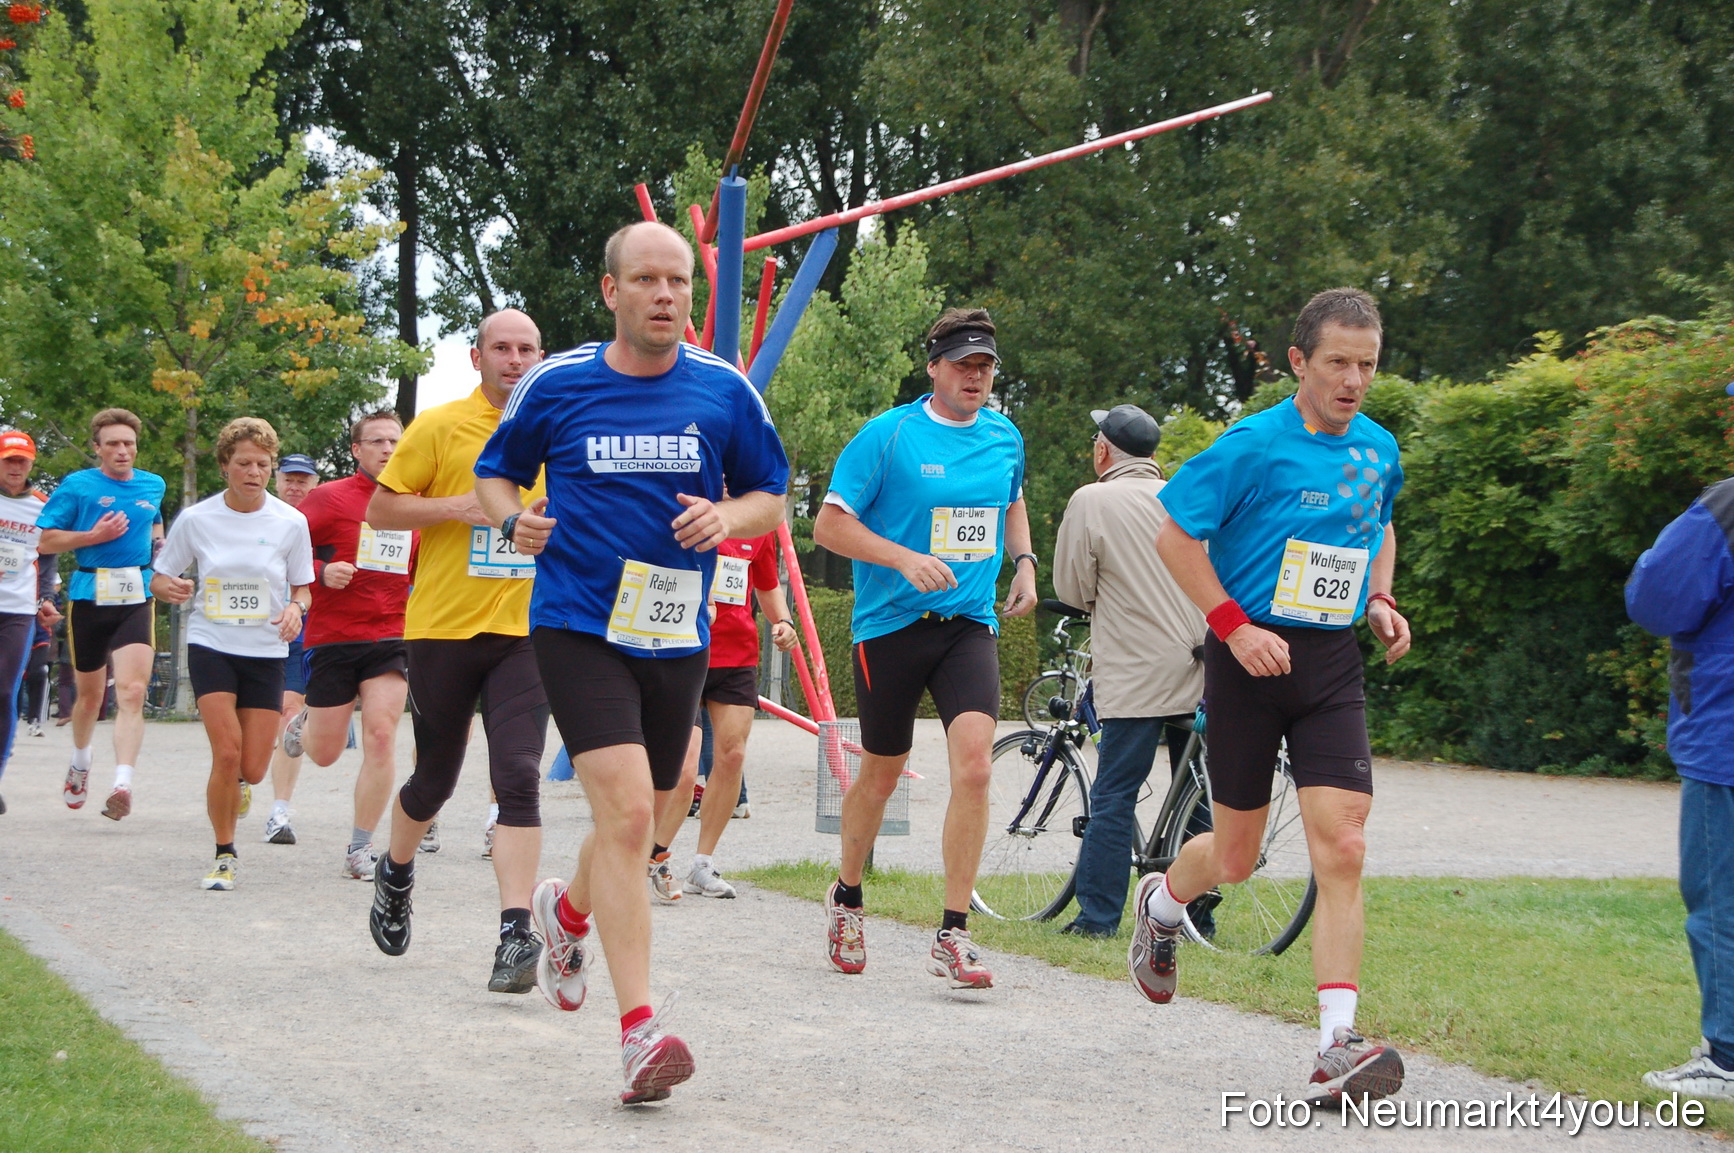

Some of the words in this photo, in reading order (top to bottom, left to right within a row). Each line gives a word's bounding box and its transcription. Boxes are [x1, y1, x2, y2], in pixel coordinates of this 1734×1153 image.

[587, 435, 701, 460] HUBER
[612, 461, 696, 471] TECHNOLOGY
[934, 523, 940, 533] C
[957, 525, 986, 542] 629
[477, 534, 483, 544] B
[380, 543, 403, 558] 797
[1310, 550, 1357, 574] Wolfgang
[1283, 569, 1291, 581] C
[119, 582, 134, 593] 76
[223, 582, 260, 591] christine
[649, 573, 677, 595] Ralph
[725, 576, 743, 589] 534
[1313, 577, 1351, 600] 628
[229, 595, 259, 610] 359
[621, 592, 629, 604] B
[649, 600, 686, 624] 323
